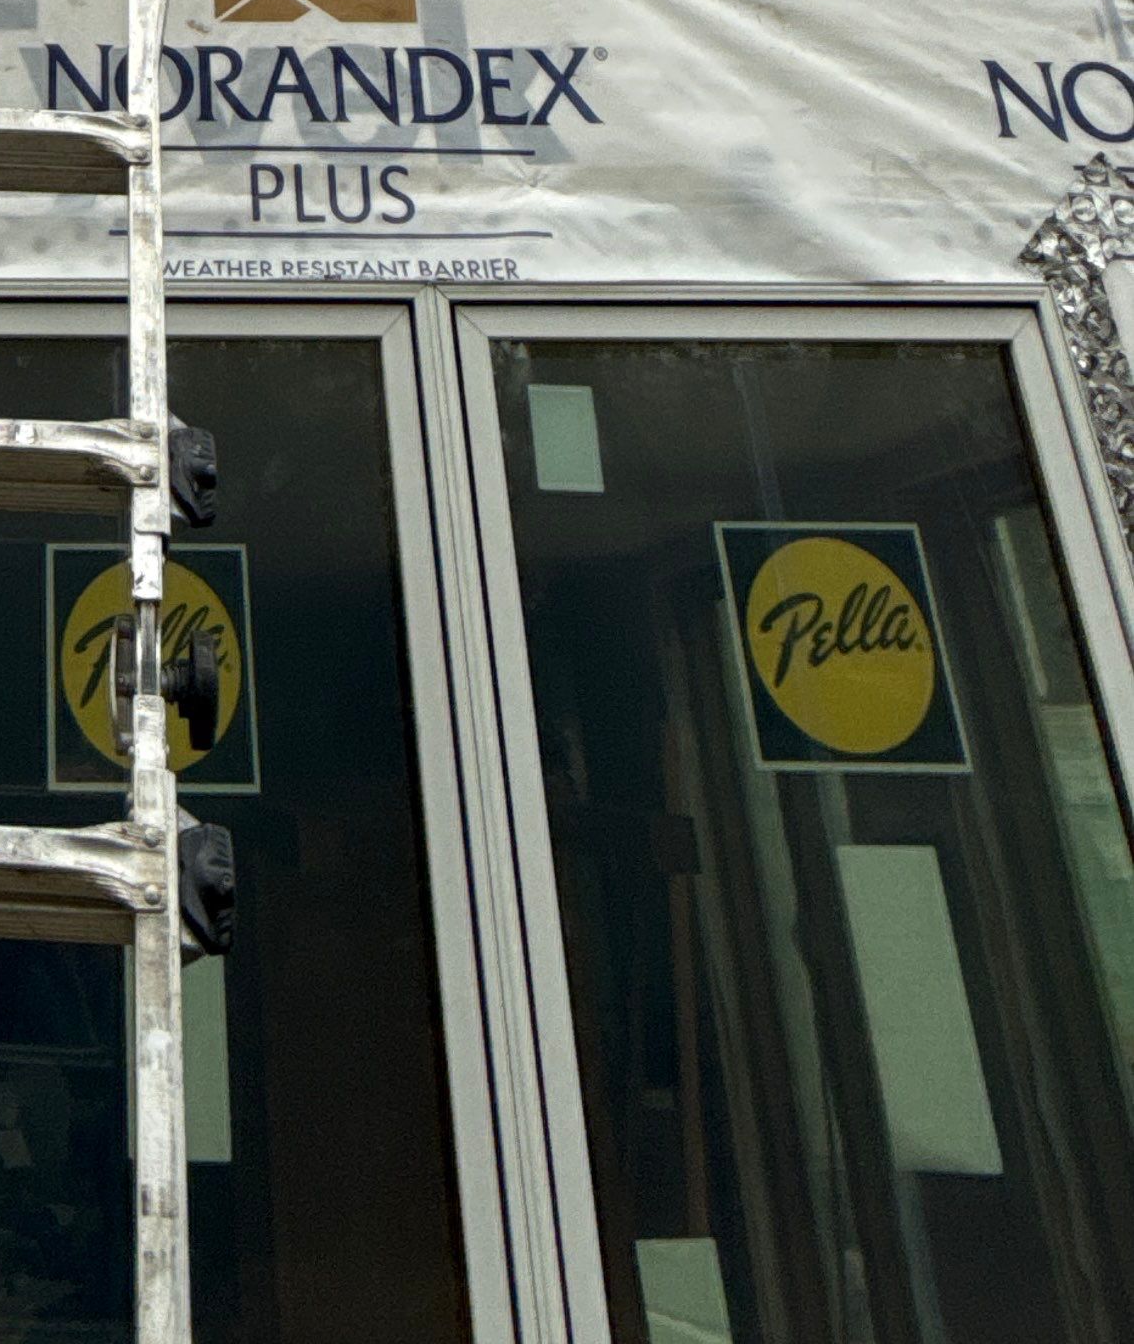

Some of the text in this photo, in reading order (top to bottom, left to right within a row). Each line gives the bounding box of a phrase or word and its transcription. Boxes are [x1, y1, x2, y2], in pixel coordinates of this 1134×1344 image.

[980, 60, 1134, 144] NO
[250, 165, 415, 224] PLUS
[164, 258, 519, 280] WEATHER RESISTANT BARRIER
[759, 583, 917, 689] Pella
